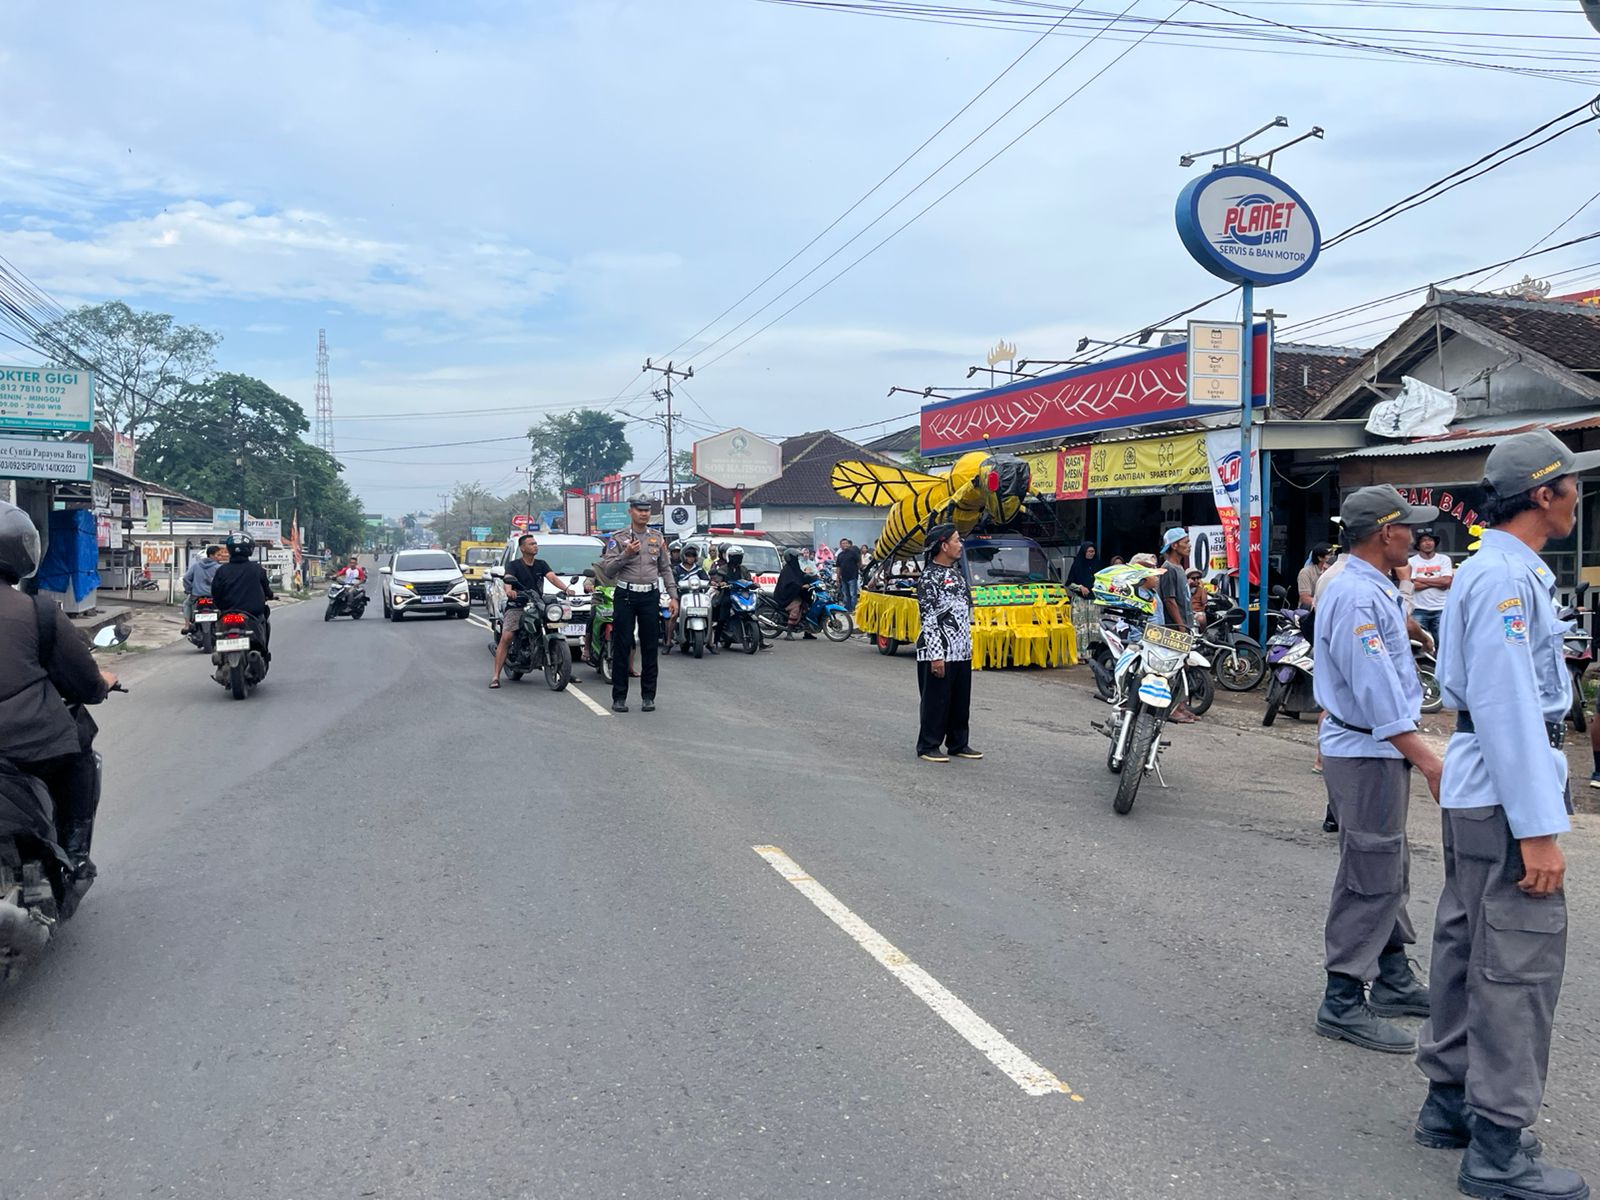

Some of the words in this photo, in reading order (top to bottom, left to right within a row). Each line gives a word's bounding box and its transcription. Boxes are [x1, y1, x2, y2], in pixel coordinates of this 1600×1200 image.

[1223, 202, 1296, 234] PLANET
[1264, 229, 1287, 244] BAN
[1219, 244, 1247, 256] SERVIS
[1248, 247, 1254, 256] &
[1256, 248, 1274, 258] BAN
[1275, 250, 1305, 262] MOTOR
[45, 373, 78, 385] GIGI
[20, 385, 41, 393] 7810
[45, 386, 66, 394] 1072
[9, 446, 32, 459] Cyntia
[66, 450, 87, 460] Barus
[1065, 457, 1081, 467] RASA
[1064, 469, 1083, 479] MESIN
[1091, 474, 1109, 483] SERVIS
[1114, 473, 1132, 481] GANTI
[1133, 472, 1146, 480] BAN
[1150, 470, 1168, 479] SPARE
[1063, 481, 1080, 491] BARU
